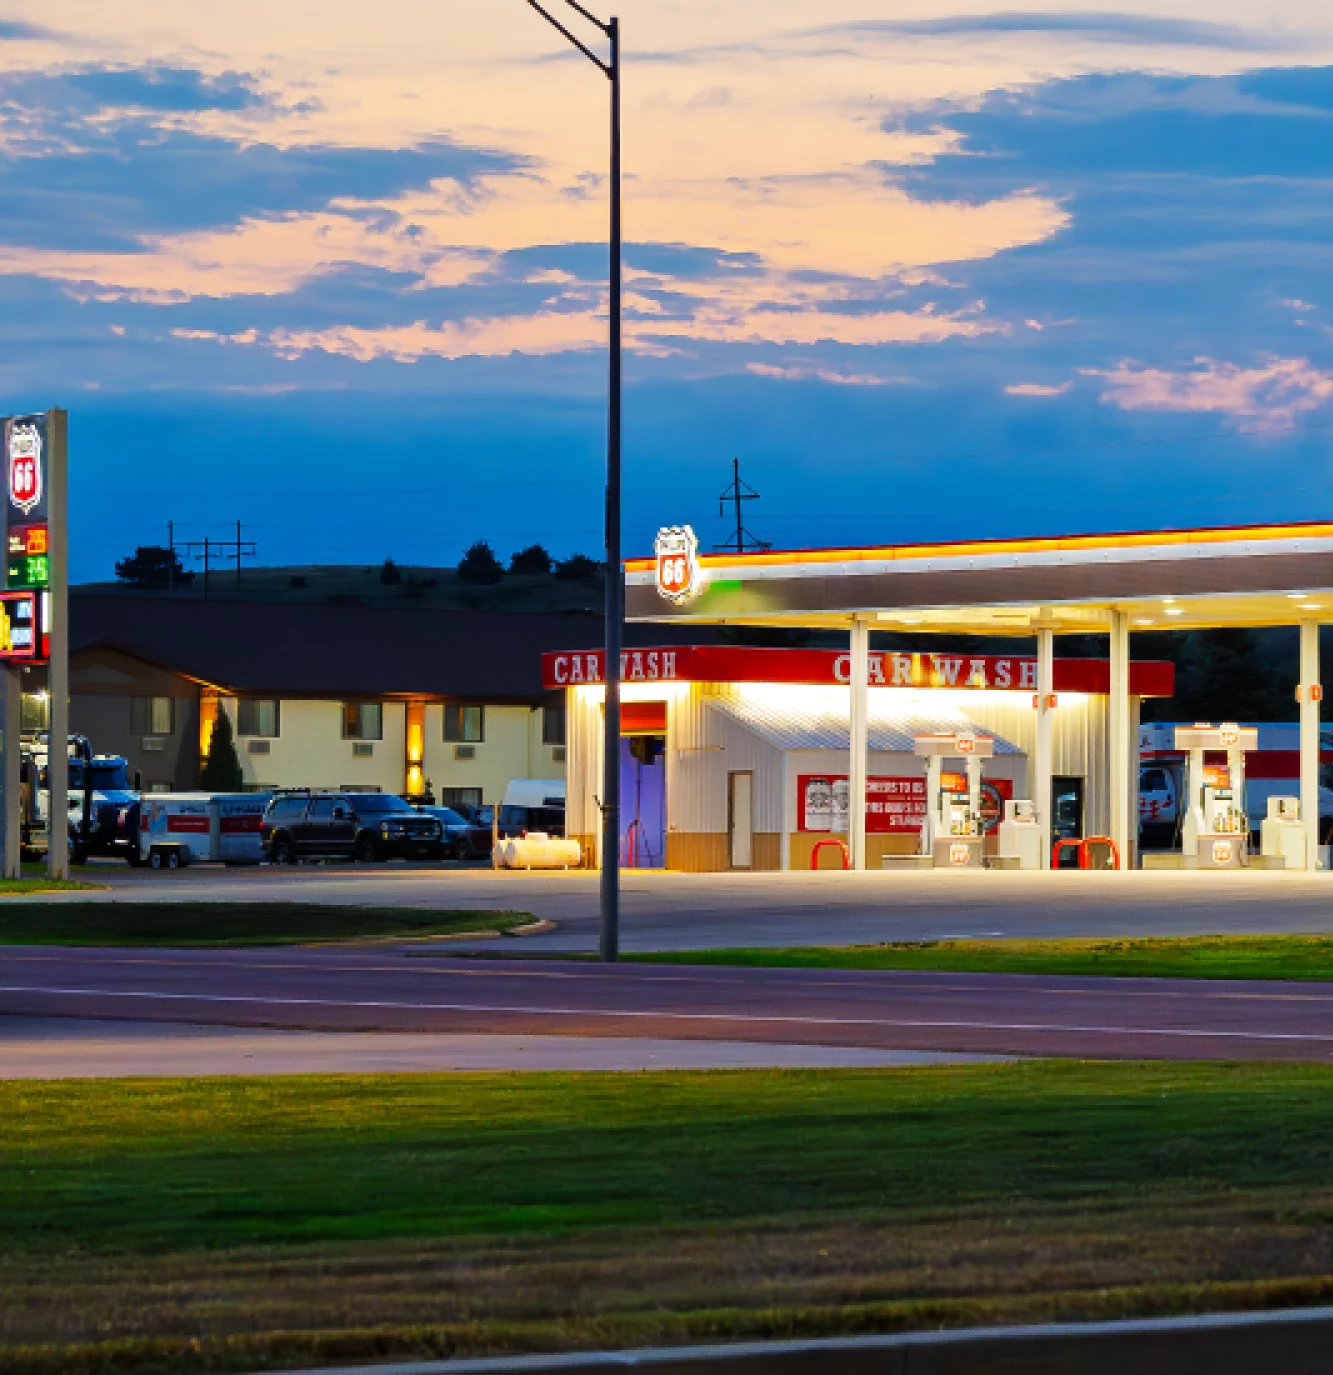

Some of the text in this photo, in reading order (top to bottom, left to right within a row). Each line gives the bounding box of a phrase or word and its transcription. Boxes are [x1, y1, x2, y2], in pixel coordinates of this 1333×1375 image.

[15, 461, 34, 492] 66
[663, 558, 686, 585] 66
[554, 655, 601, 683] CAR
